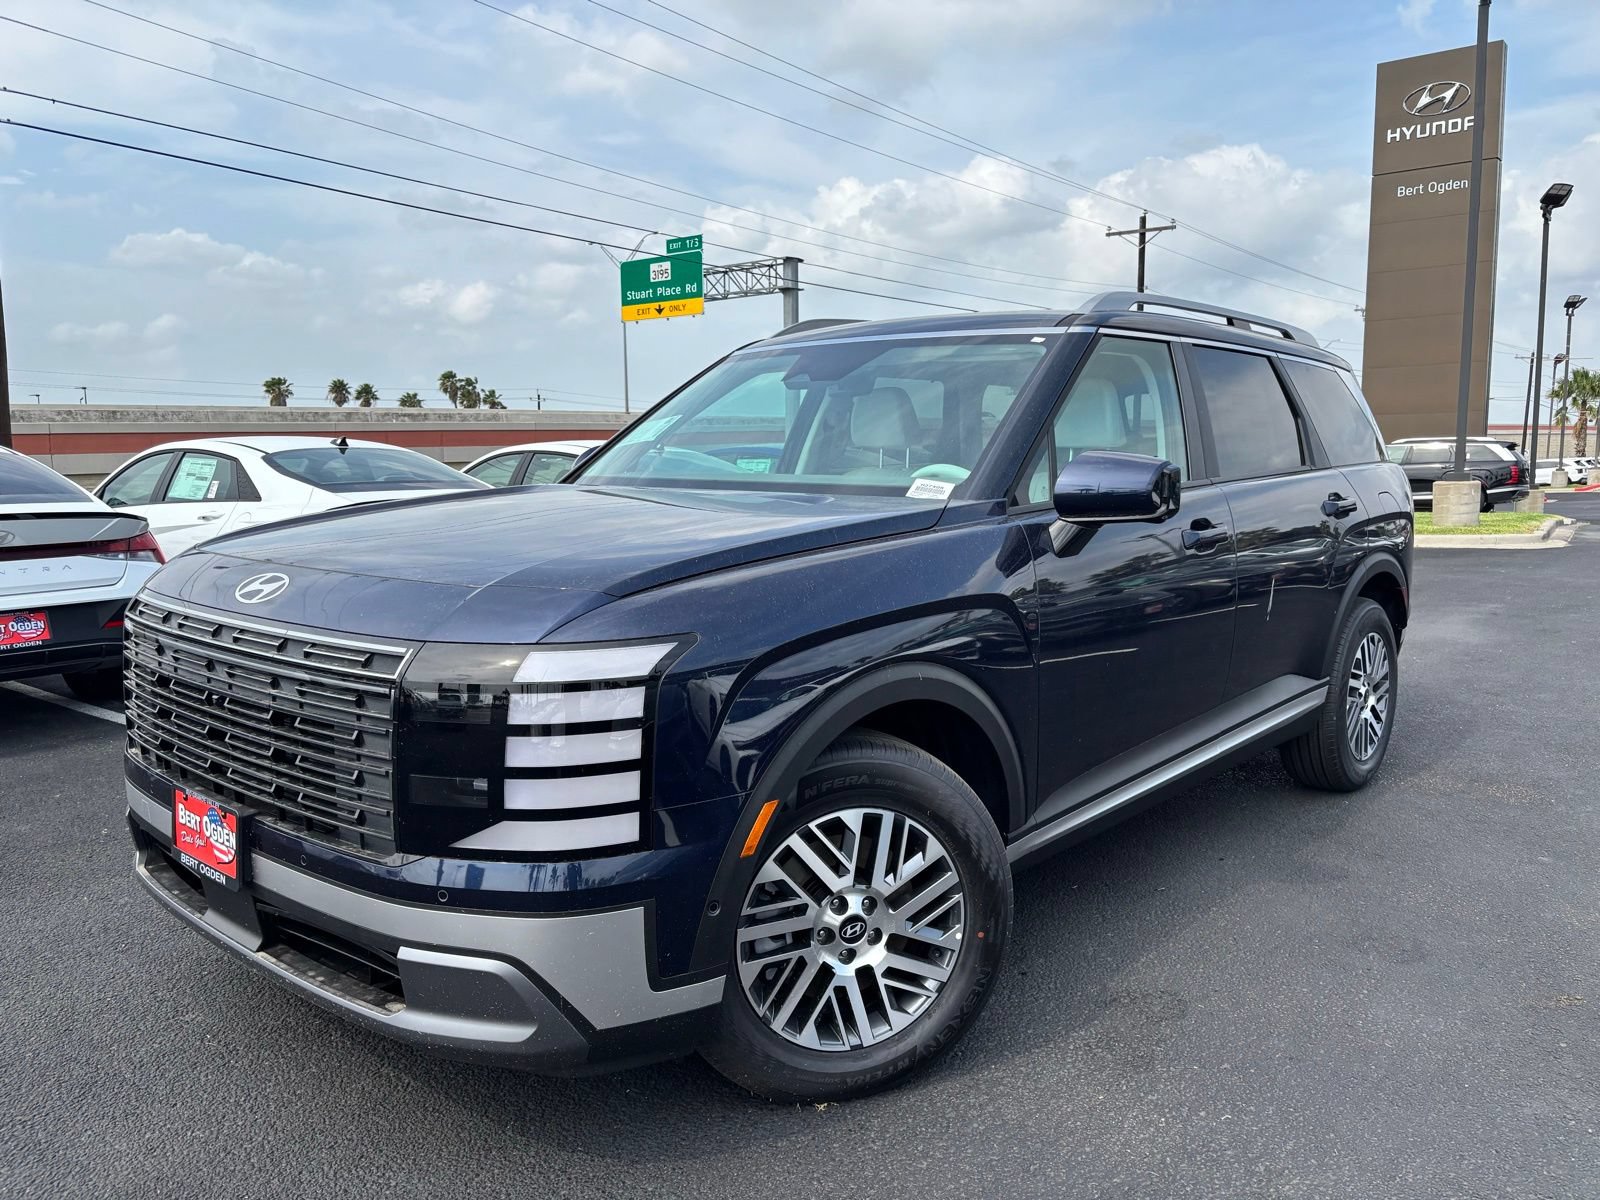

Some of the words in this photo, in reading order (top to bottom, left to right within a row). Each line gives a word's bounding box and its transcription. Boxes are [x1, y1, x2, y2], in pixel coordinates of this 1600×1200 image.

[1387, 116, 1474, 143] HYUNDA
[1398, 184, 1424, 197] Bert
[1428, 179, 1469, 195] Ogden
[669, 241, 681, 250] EXIT
[686, 238, 699, 249] 173
[652, 268, 669, 280] 3195
[626, 289, 653, 300] Stuart
[657, 286, 681, 297] Place
[686, 282, 697, 293] Rd
[637, 307, 650, 315] EXIT
[668, 304, 686, 312] ONLY
[8, 620, 45, 632] OGDEN
[13, 640, 43, 649] OGDEN
[178, 803, 201, 833] BERT
[202, 815, 236, 850] OGDEN
[180, 853, 198, 870] BERT
[199, 864, 226, 885] OGDEN
